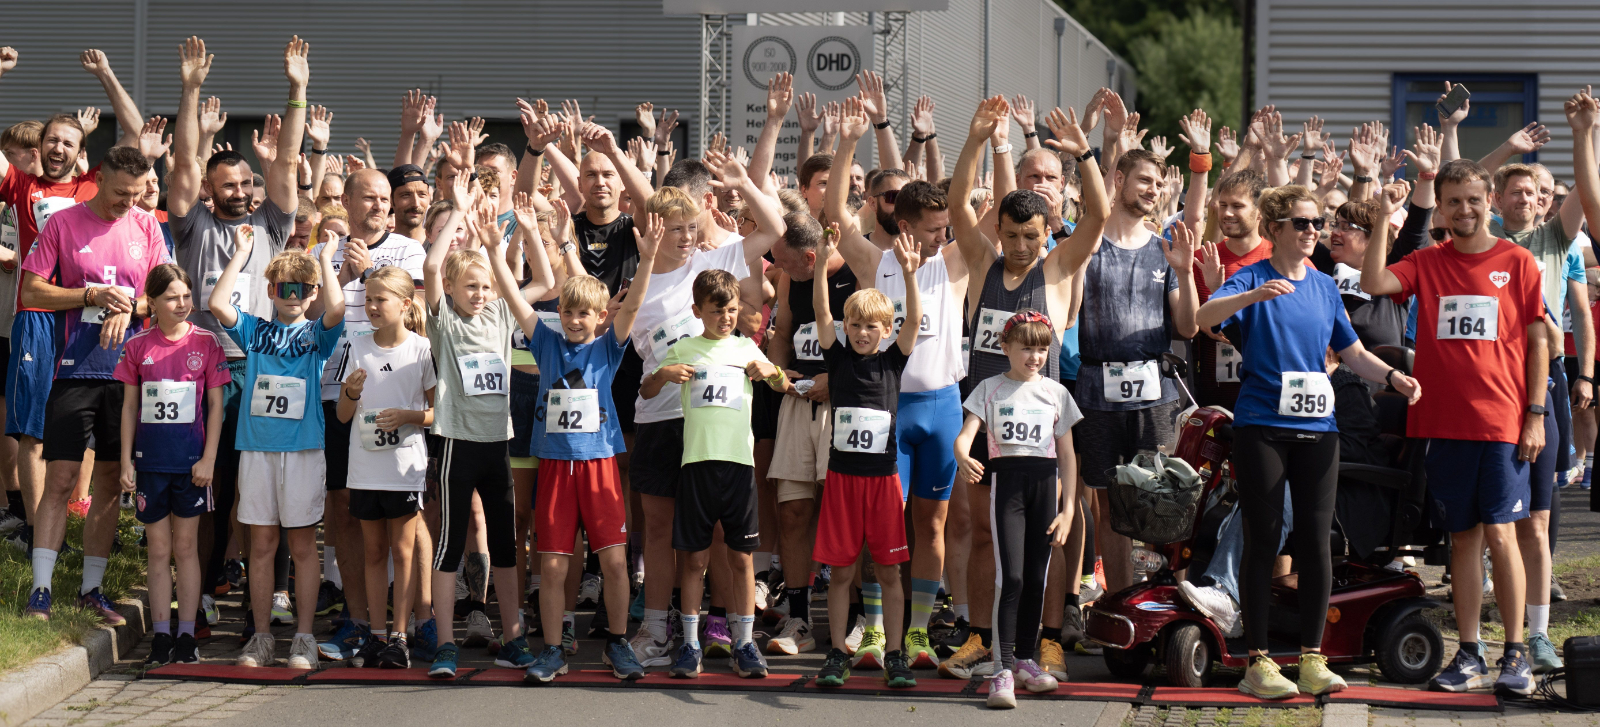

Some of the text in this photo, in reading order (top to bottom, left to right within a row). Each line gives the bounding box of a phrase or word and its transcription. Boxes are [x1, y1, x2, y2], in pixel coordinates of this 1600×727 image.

[816, 54, 852, 71] DHD
[1448, 316, 1486, 336] 164
[474, 372, 503, 391] 487
[1120, 380, 1144, 398] 97
[702, 384, 728, 404] 44
[1290, 393, 1326, 414] 359
[154, 402, 178, 420] 33
[265, 395, 288, 414] 79
[558, 410, 583, 430] 42
[374, 428, 400, 447] 38
[846, 429, 874, 450] 49
[1002, 422, 1042, 443] 394
